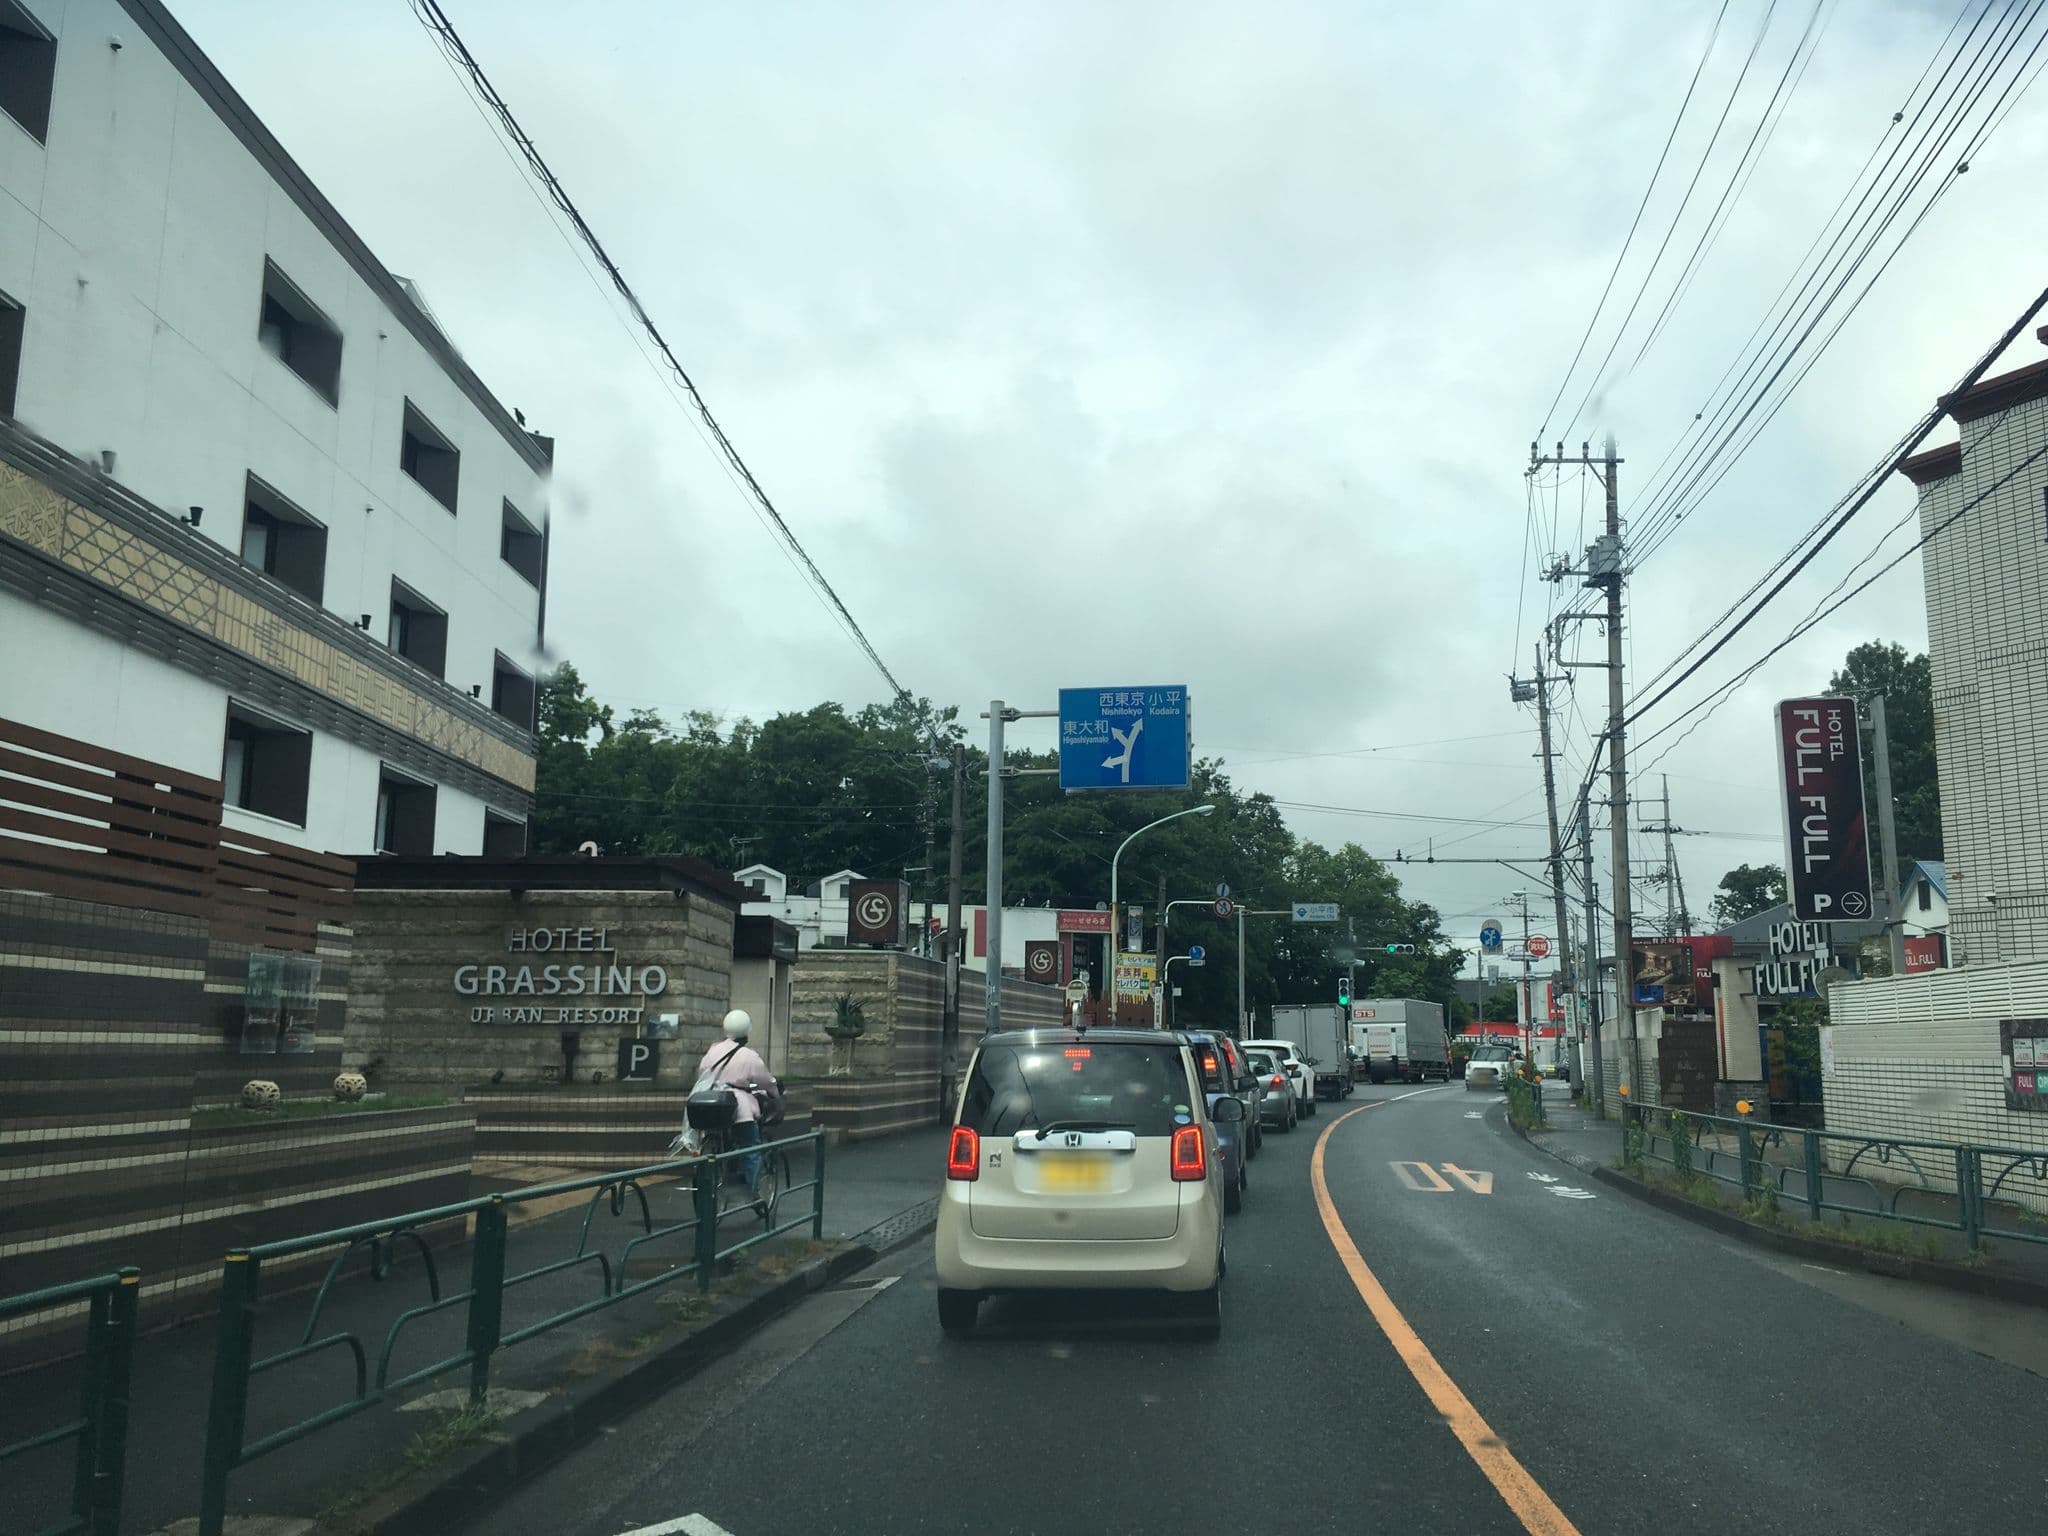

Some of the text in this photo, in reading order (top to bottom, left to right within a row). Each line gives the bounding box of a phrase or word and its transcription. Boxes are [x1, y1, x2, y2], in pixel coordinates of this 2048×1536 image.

[1100, 691, 1180, 706] 西東京 小平
[1102, 707, 1180, 716] Nishitokyo Kodaira
[1063, 720, 1109, 735] 東大和
[1827, 709, 1844, 761] HOTEL
[1793, 709, 1830, 873] FULL FULL
[1814, 894, 1832, 913] P
[509, 927, 615, 952] HOTEL
[1769, 921, 1827, 955] HOTEL
[1905, 956, 1918, 966] ULL
[454, 965, 668, 995] GRASSINO
[1756, 955, 1840, 995] FULL FU
[559, 1007, 642, 1023] RESORT
[631, 1044, 650, 1071] P
[2018, 1076, 2033, 1088] FULL
